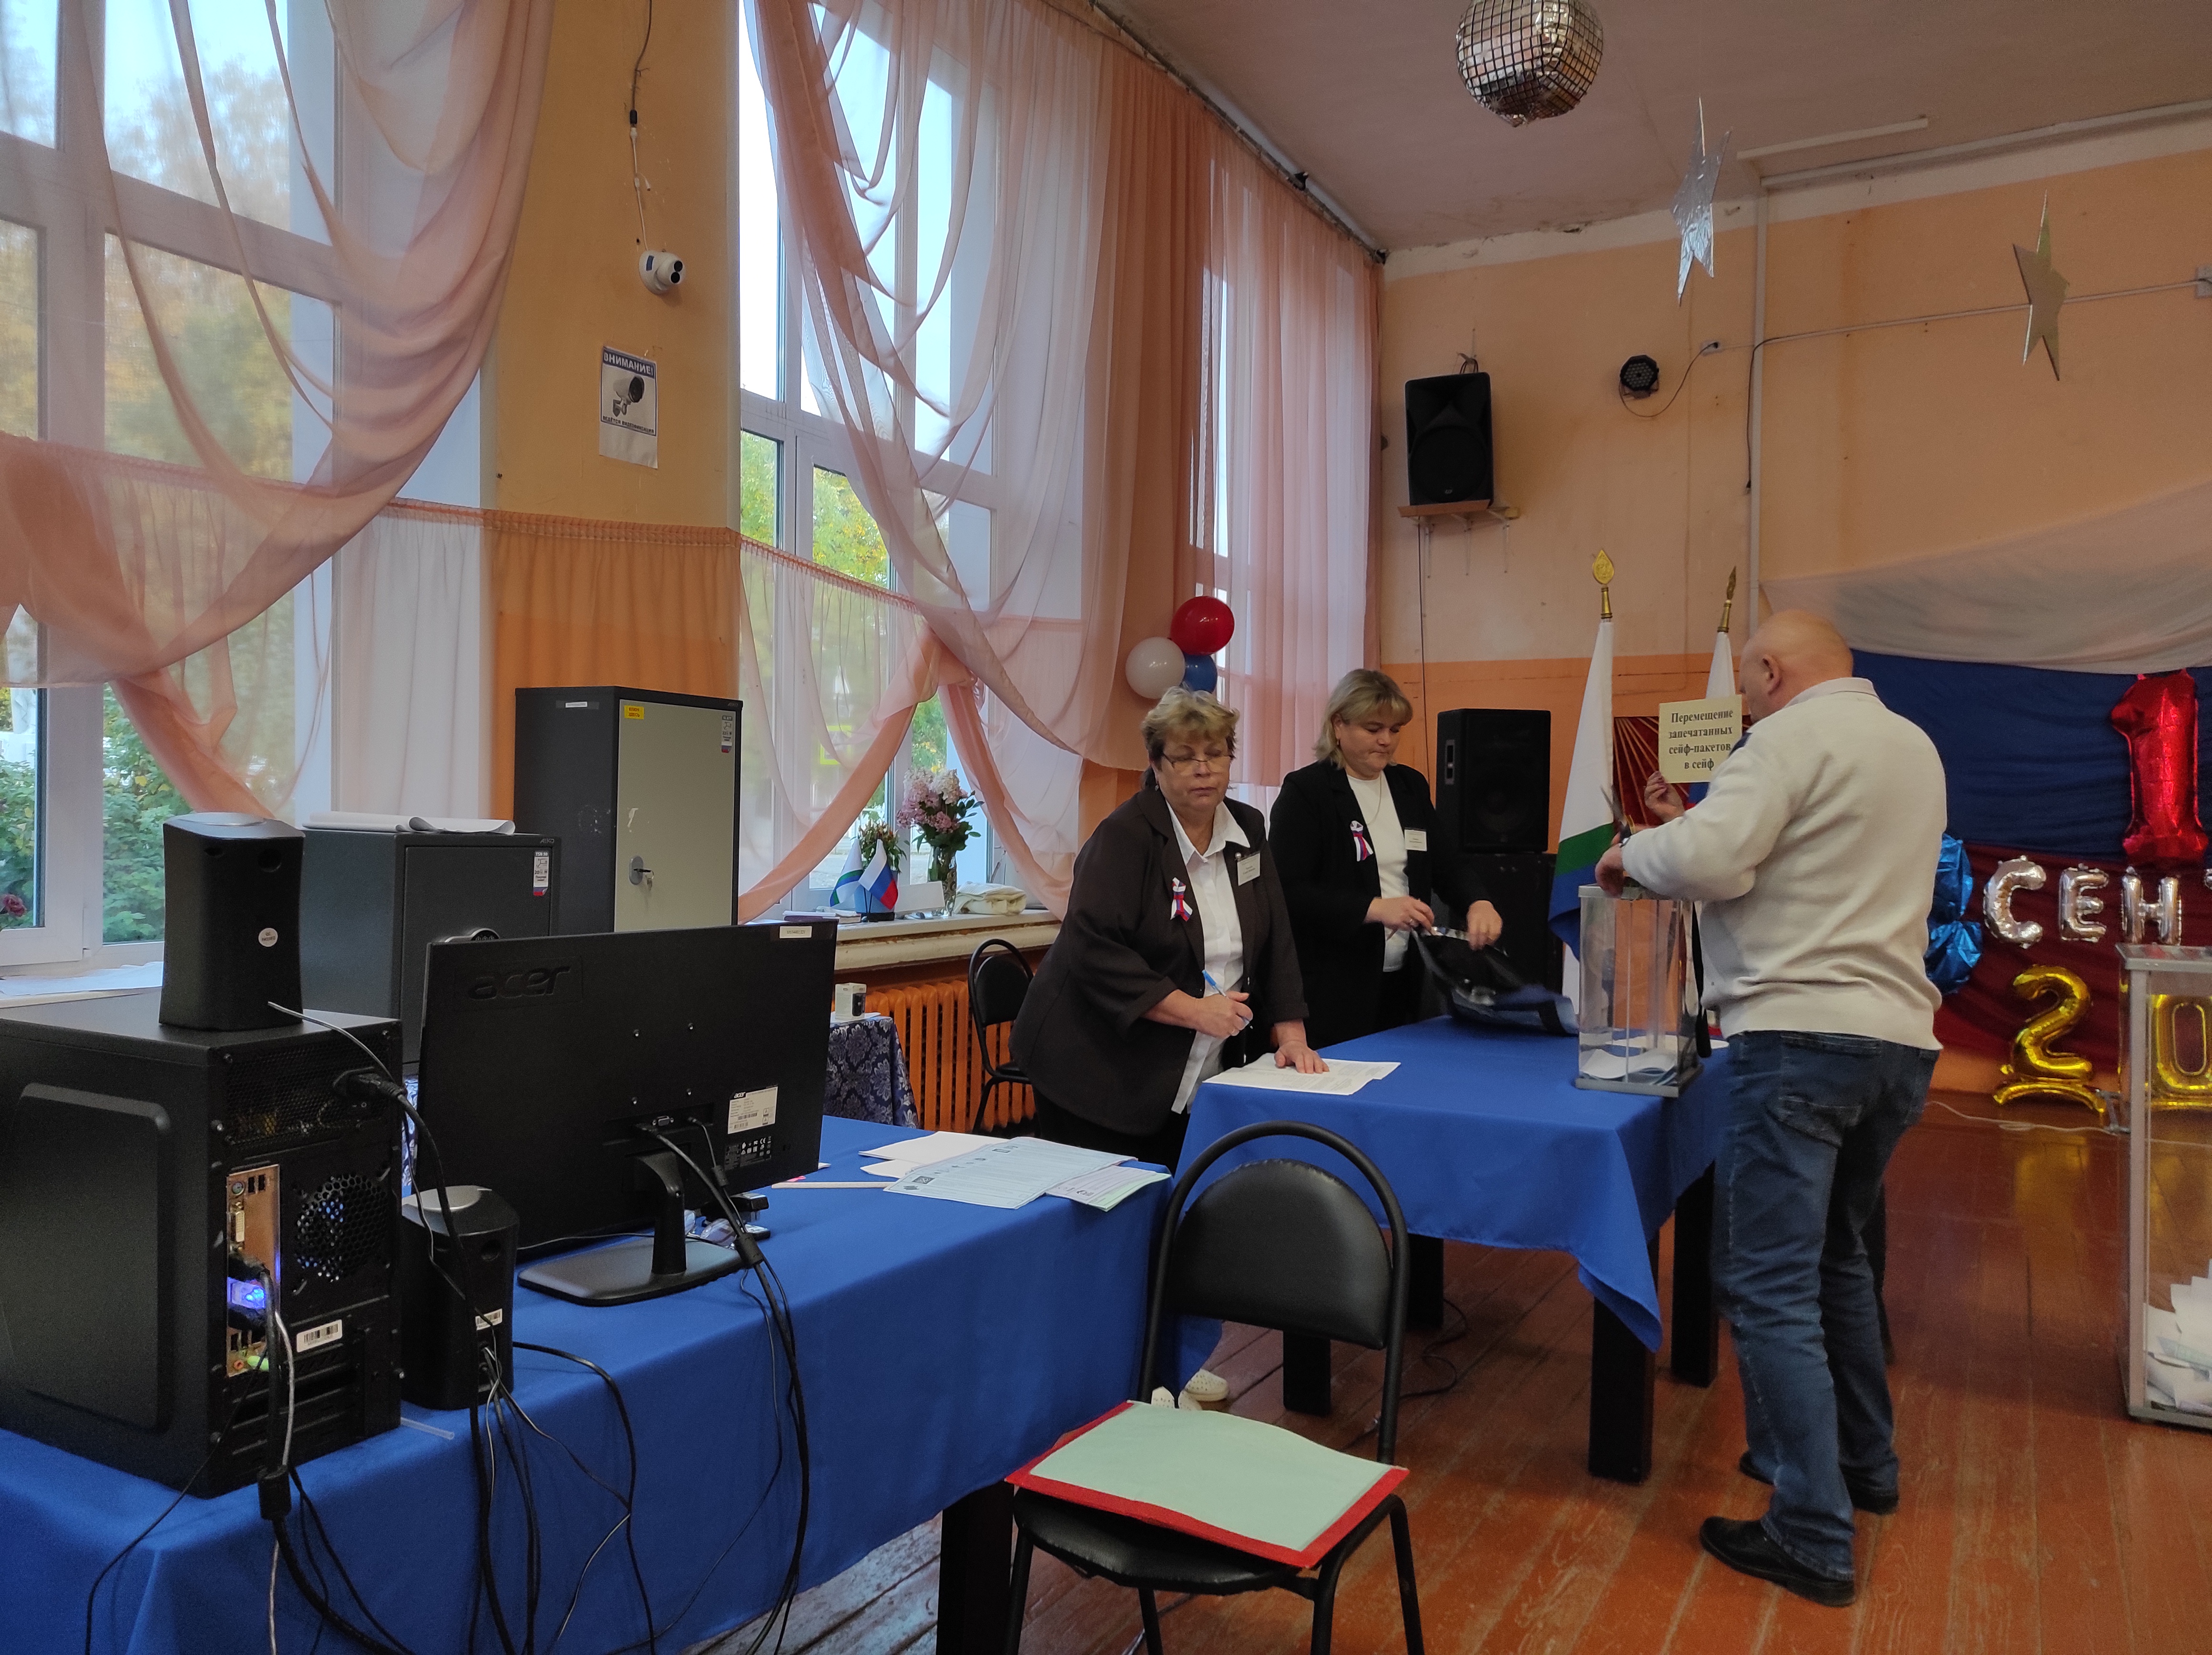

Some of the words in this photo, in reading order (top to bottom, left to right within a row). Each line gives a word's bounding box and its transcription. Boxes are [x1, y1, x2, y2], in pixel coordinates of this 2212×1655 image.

[604, 352, 653, 376] ВНИМАНИЕ!
[1671, 710, 1733, 725] Перемещение
[1669, 727, 1732, 738] запечатанных
[1669, 744, 1731, 756] сейф-пакетов
[1692, 758, 1714, 771] сейф
[1983, 856, 2212, 949] СЕН
[468, 966, 571, 1001] acer
